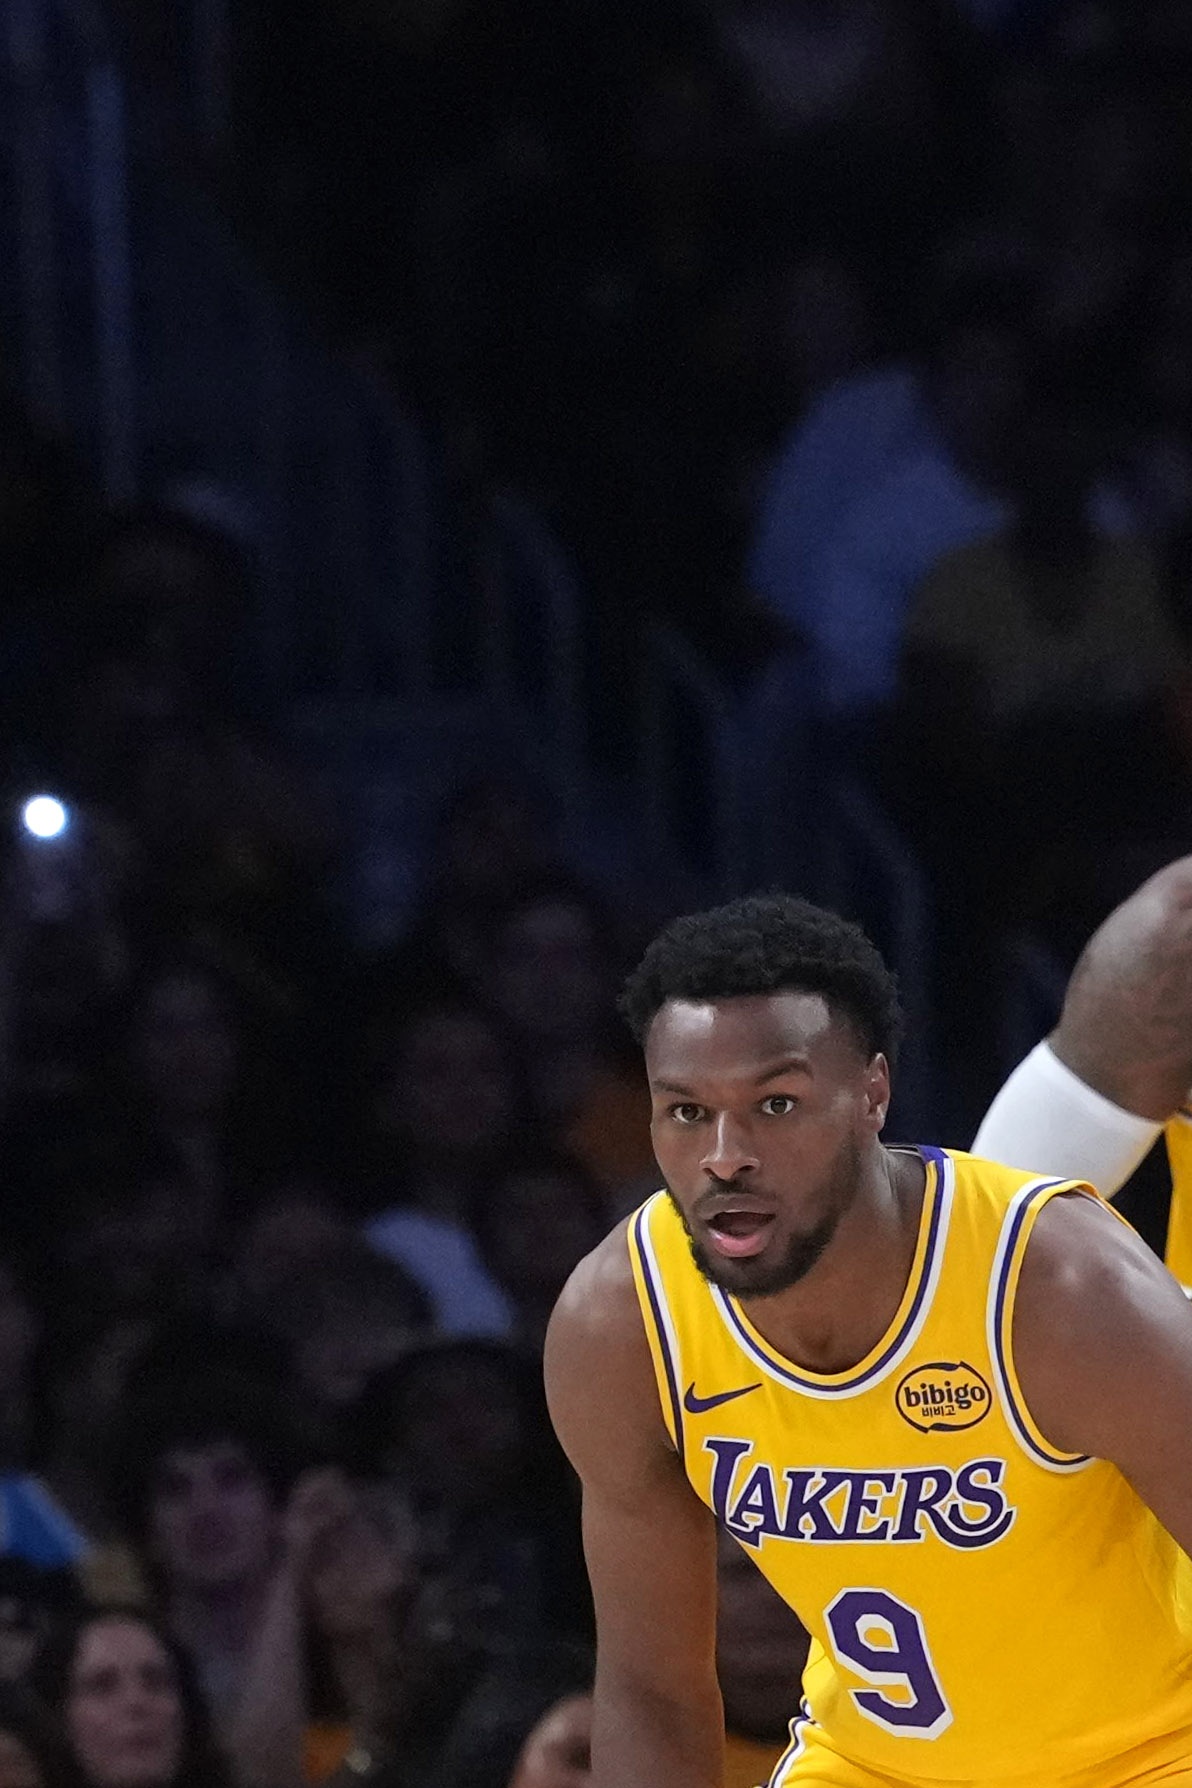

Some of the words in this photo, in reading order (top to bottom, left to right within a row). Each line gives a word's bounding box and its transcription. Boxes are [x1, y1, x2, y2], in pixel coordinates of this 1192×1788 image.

[903, 1380, 986, 1410] bibigo
[921, 1404, 957, 1418] 비비고
[704, 1437, 1016, 1551] LAKERS
[823, 1587, 955, 1741] 9
